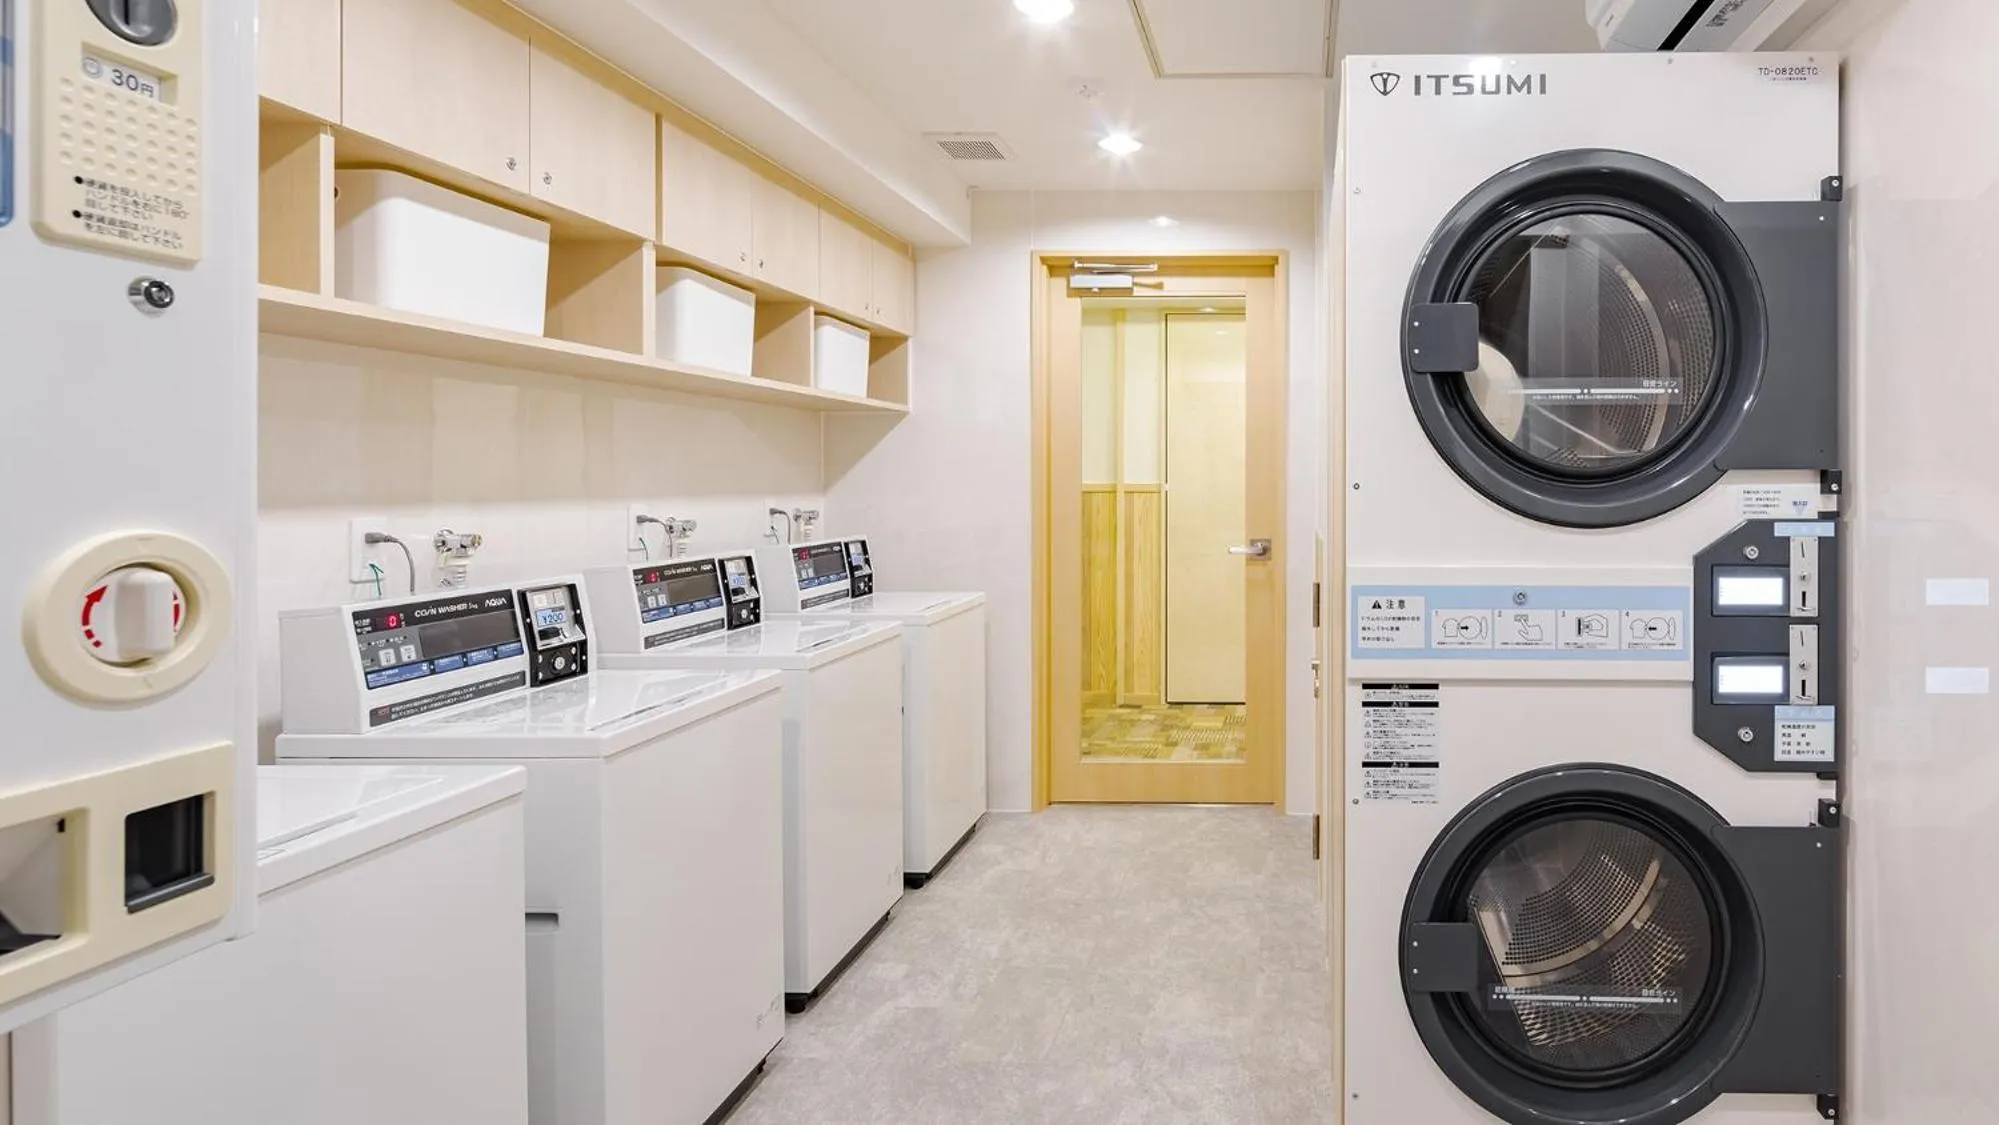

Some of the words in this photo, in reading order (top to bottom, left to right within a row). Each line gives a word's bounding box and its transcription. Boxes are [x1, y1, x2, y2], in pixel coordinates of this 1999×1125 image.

[1758, 66, 1819, 76] TD-0820ETC
[111, 68, 154, 98] 30円
[1413, 73, 1548, 96] ITSUMI
[437, 602, 468, 614] WASHER
[484, 596, 507, 608] AQUA
[1385, 599, 1406, 610] 注意
[387, 614, 397, 627] 0
